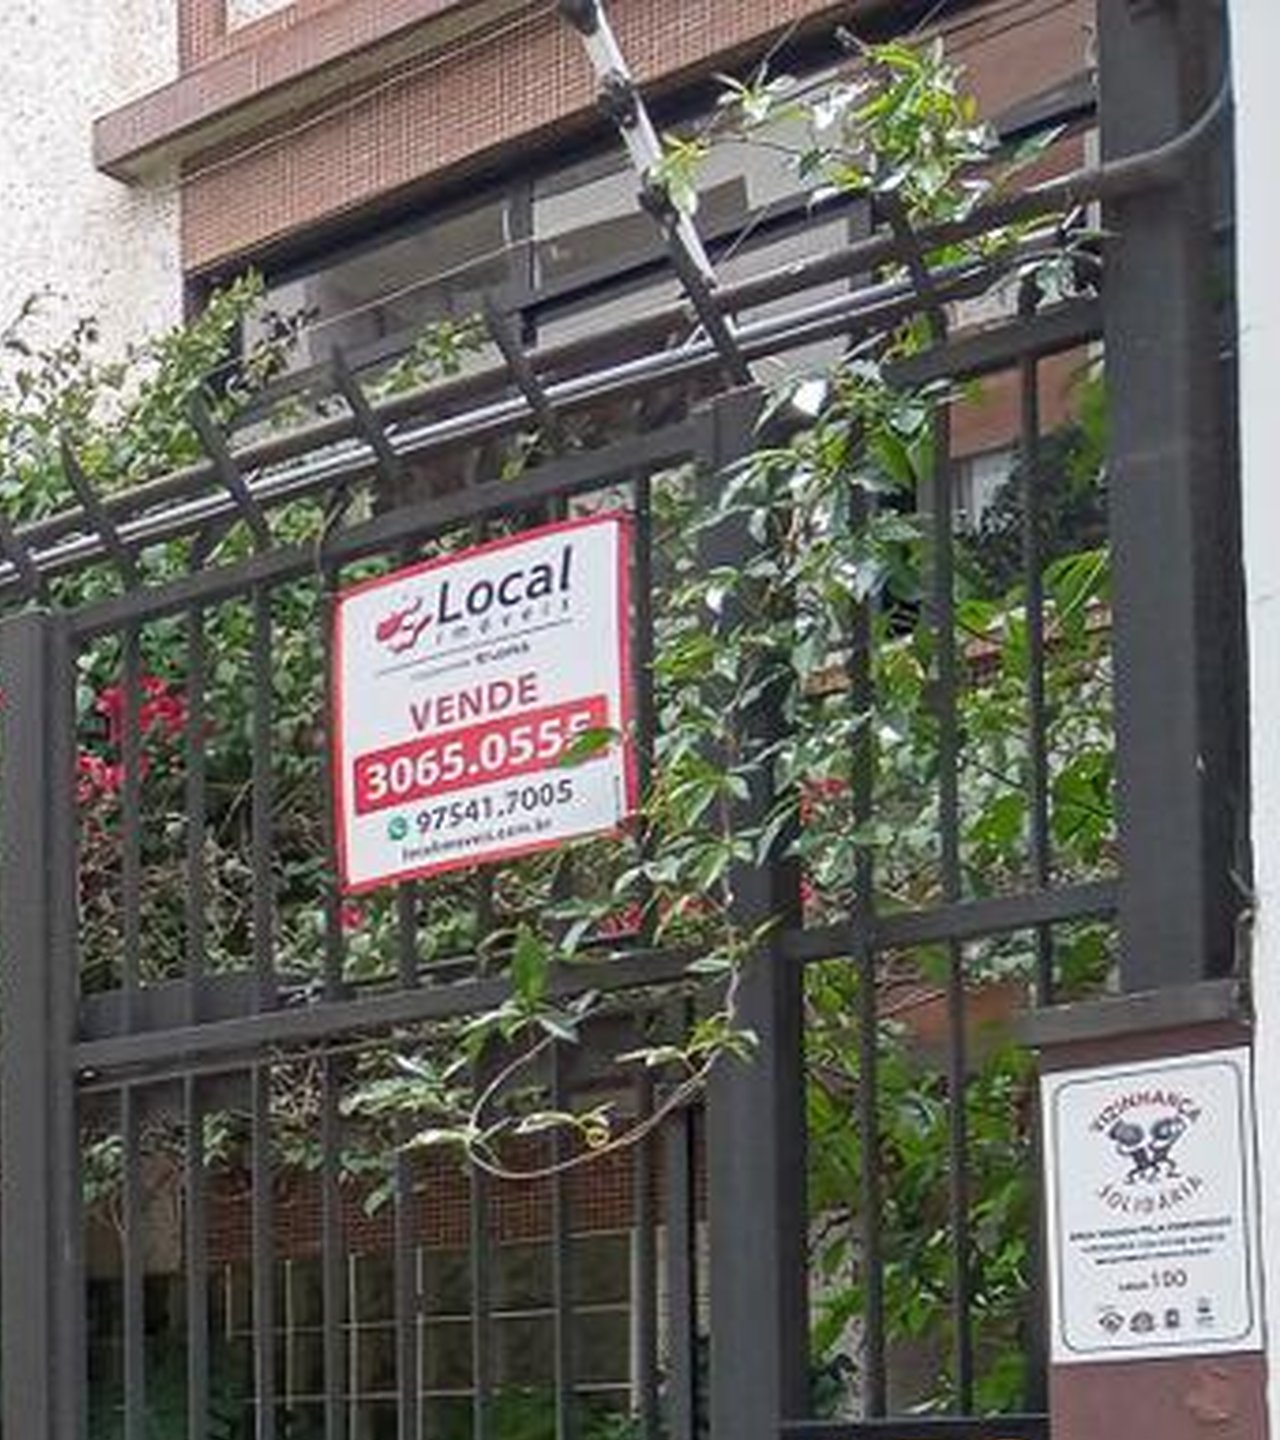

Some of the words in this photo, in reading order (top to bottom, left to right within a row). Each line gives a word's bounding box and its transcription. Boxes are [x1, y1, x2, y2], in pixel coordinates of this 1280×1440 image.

[438, 544, 573, 624] Local
[410, 672, 539, 732] VENDE
[416, 778, 573, 834] 97541.7005
